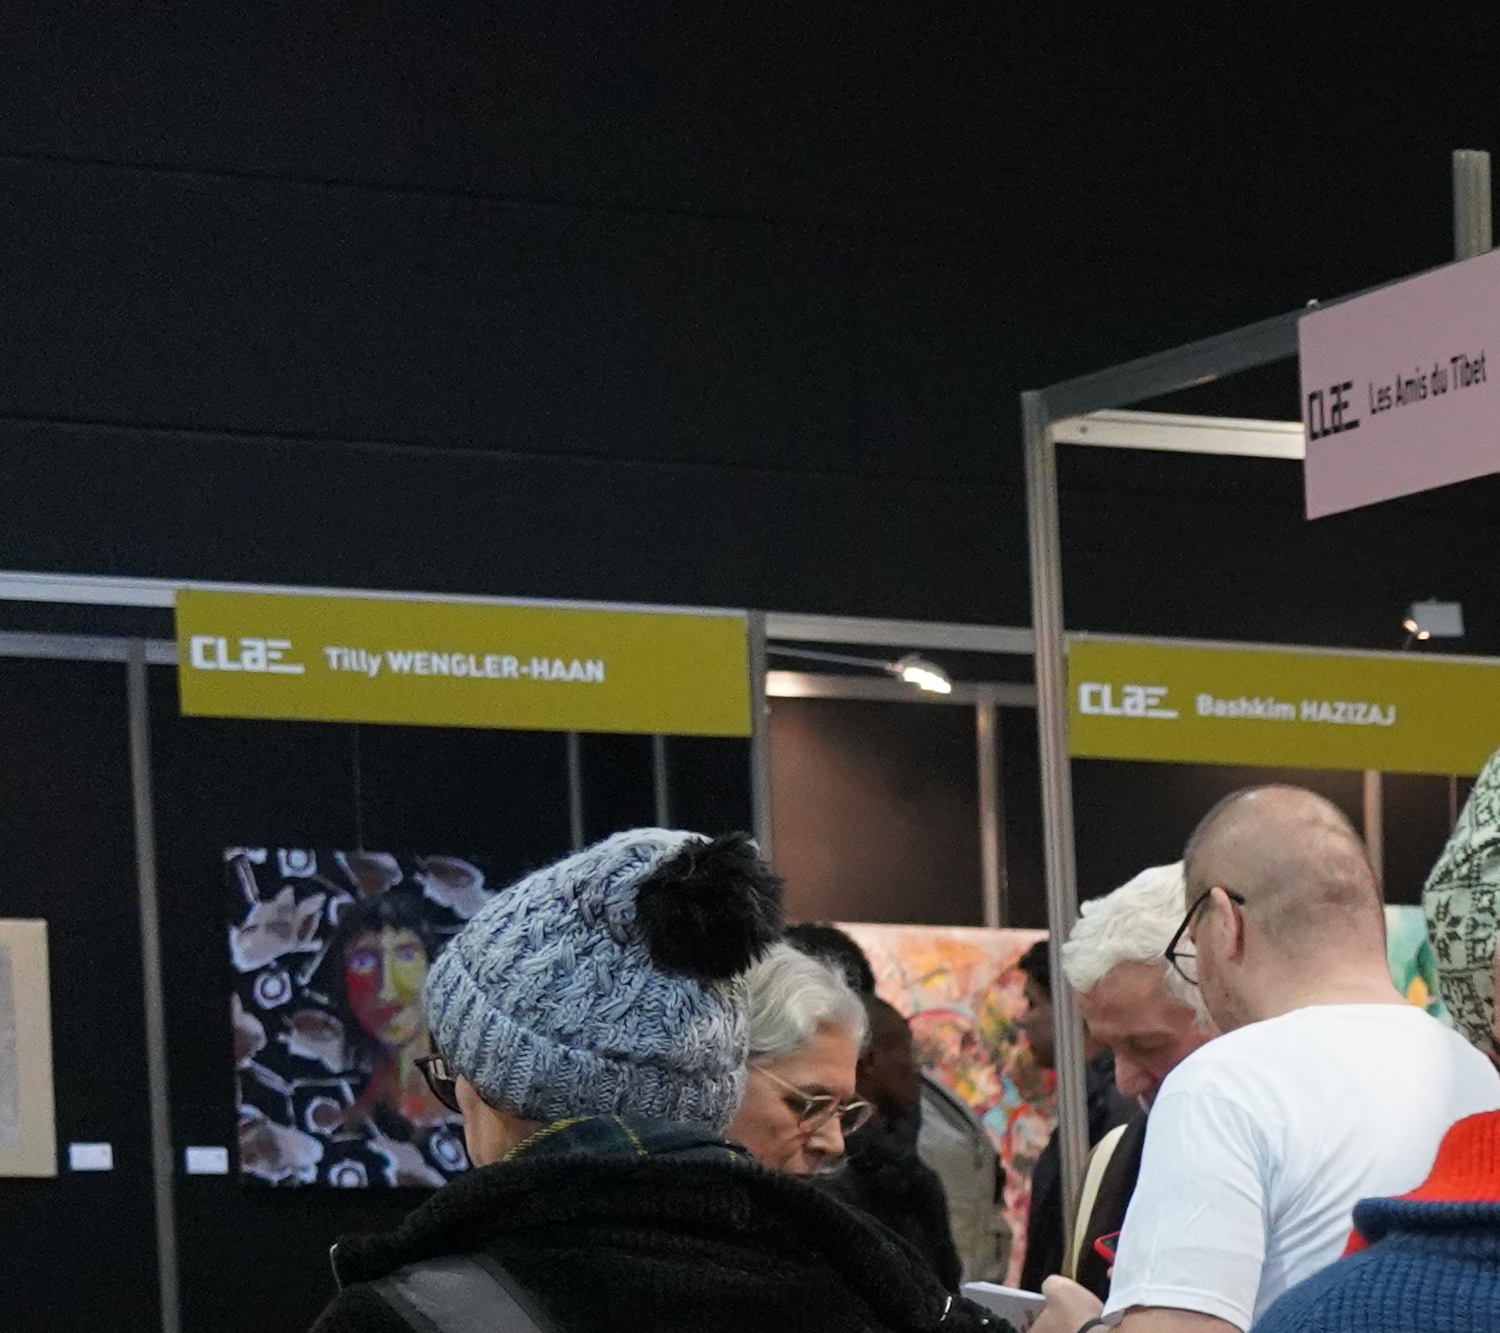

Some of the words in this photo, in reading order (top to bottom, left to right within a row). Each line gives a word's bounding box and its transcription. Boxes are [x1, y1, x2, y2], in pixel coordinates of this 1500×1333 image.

[1369, 382, 1391, 415] Les
[1396, 366, 1428, 406] Amis
[1430, 363, 1448, 396] du
[1450, 350, 1486, 390] Tibet
[324, 646, 381, 677] Tilly
[386, 650, 605, 683] WENGLER-HAAN
[1196, 694, 1295, 719] Bashkim
[1300, 700, 1396, 725] HAZIZAJ
